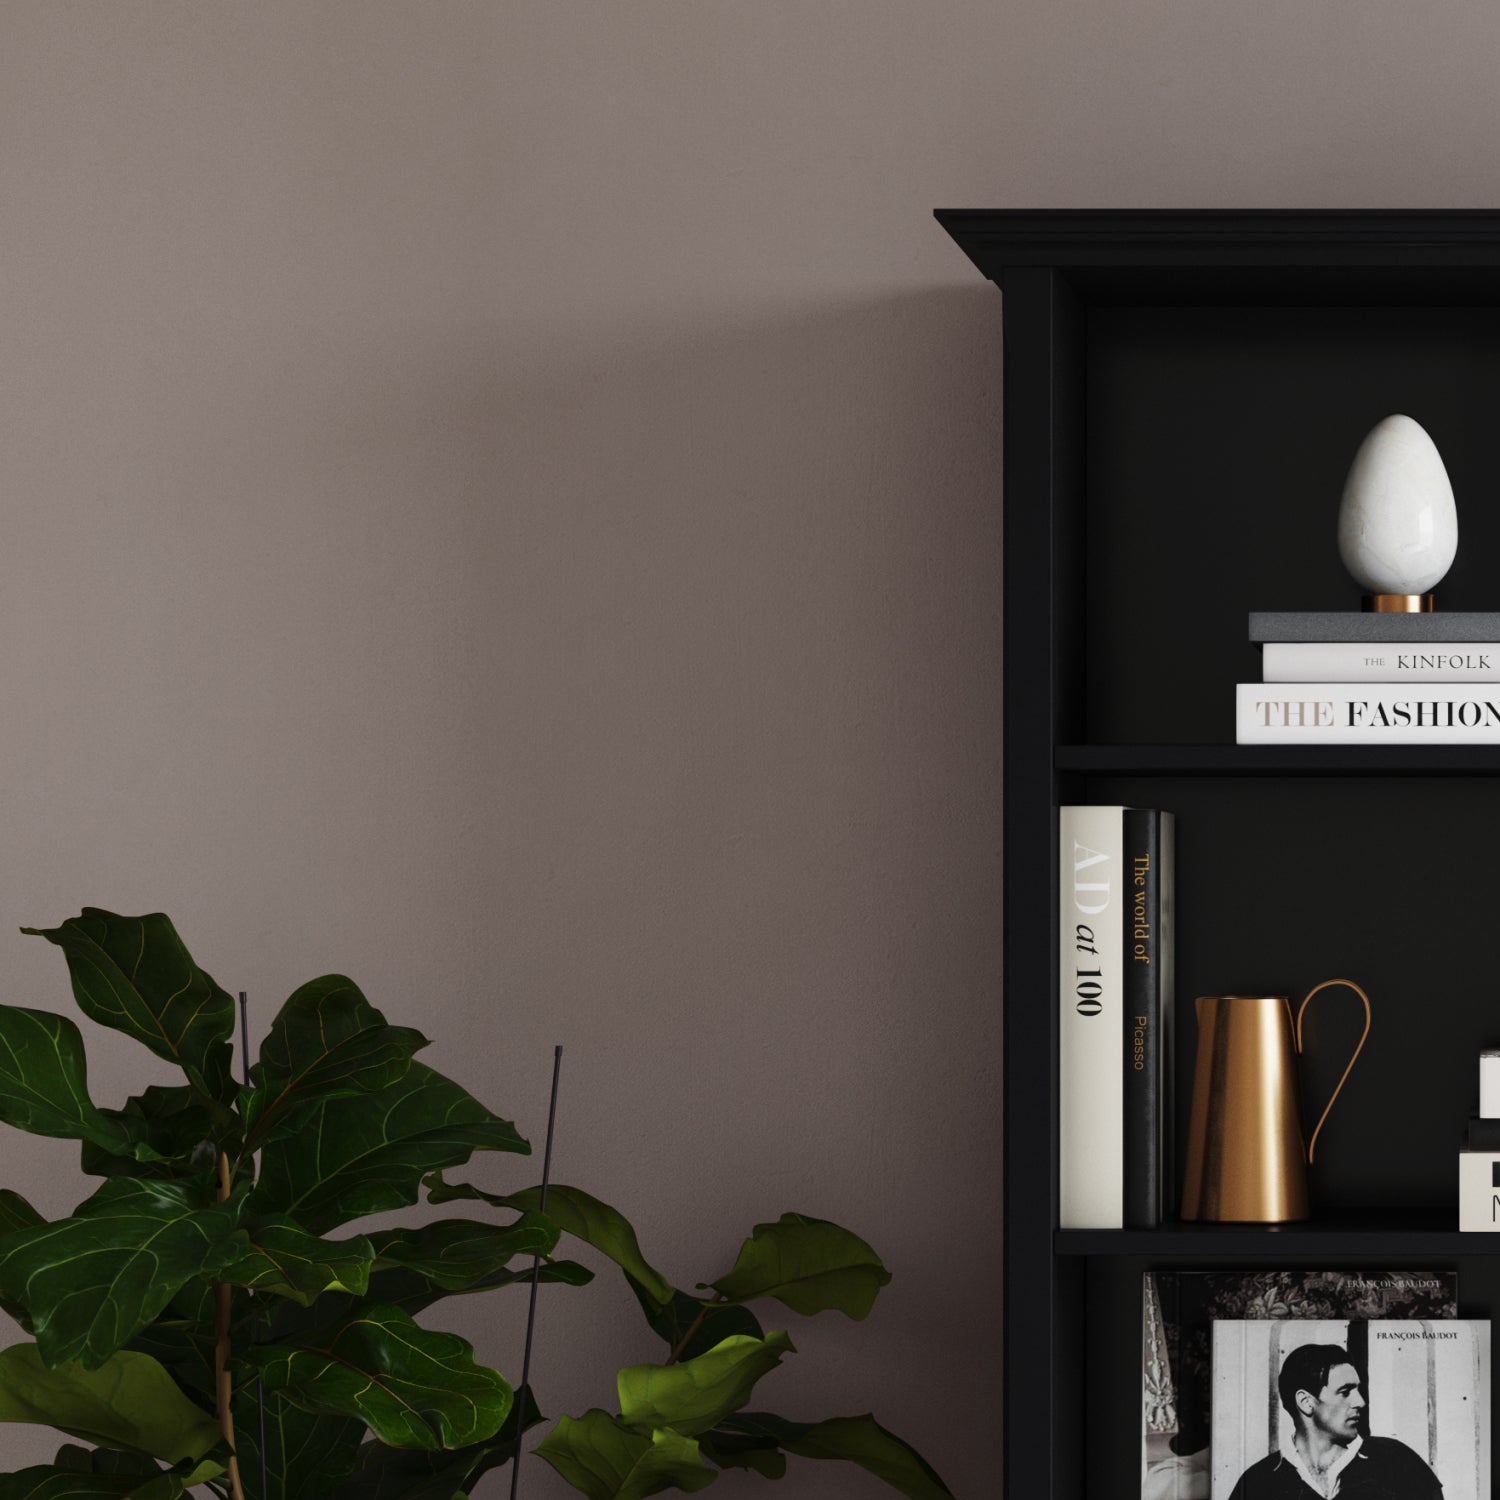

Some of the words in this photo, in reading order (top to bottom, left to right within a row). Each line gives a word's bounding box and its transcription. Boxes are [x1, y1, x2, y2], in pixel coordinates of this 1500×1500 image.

[1365, 657, 1385, 667] THE
[1397, 655, 1491, 669] KINFOLK
[1255, 701, 1334, 727] THE
[1074, 840, 1111, 915] AD
[1134, 853, 1149, 885] The
[1134, 890, 1151, 939] world
[1075, 924, 1099, 955] at
[1134, 944, 1151, 965] of
[1076, 965, 1103, 1017] 100
[1134, 1016, 1147, 1071] Picasso
[1347, 1279, 1397, 1290] FRANÇOIS
[1398, 1280, 1441, 1288] BAUDOT
[1376, 1332, 1421, 1341] FRANÇOIS
[1422, 1332, 1459, 1340] BAUDOT
